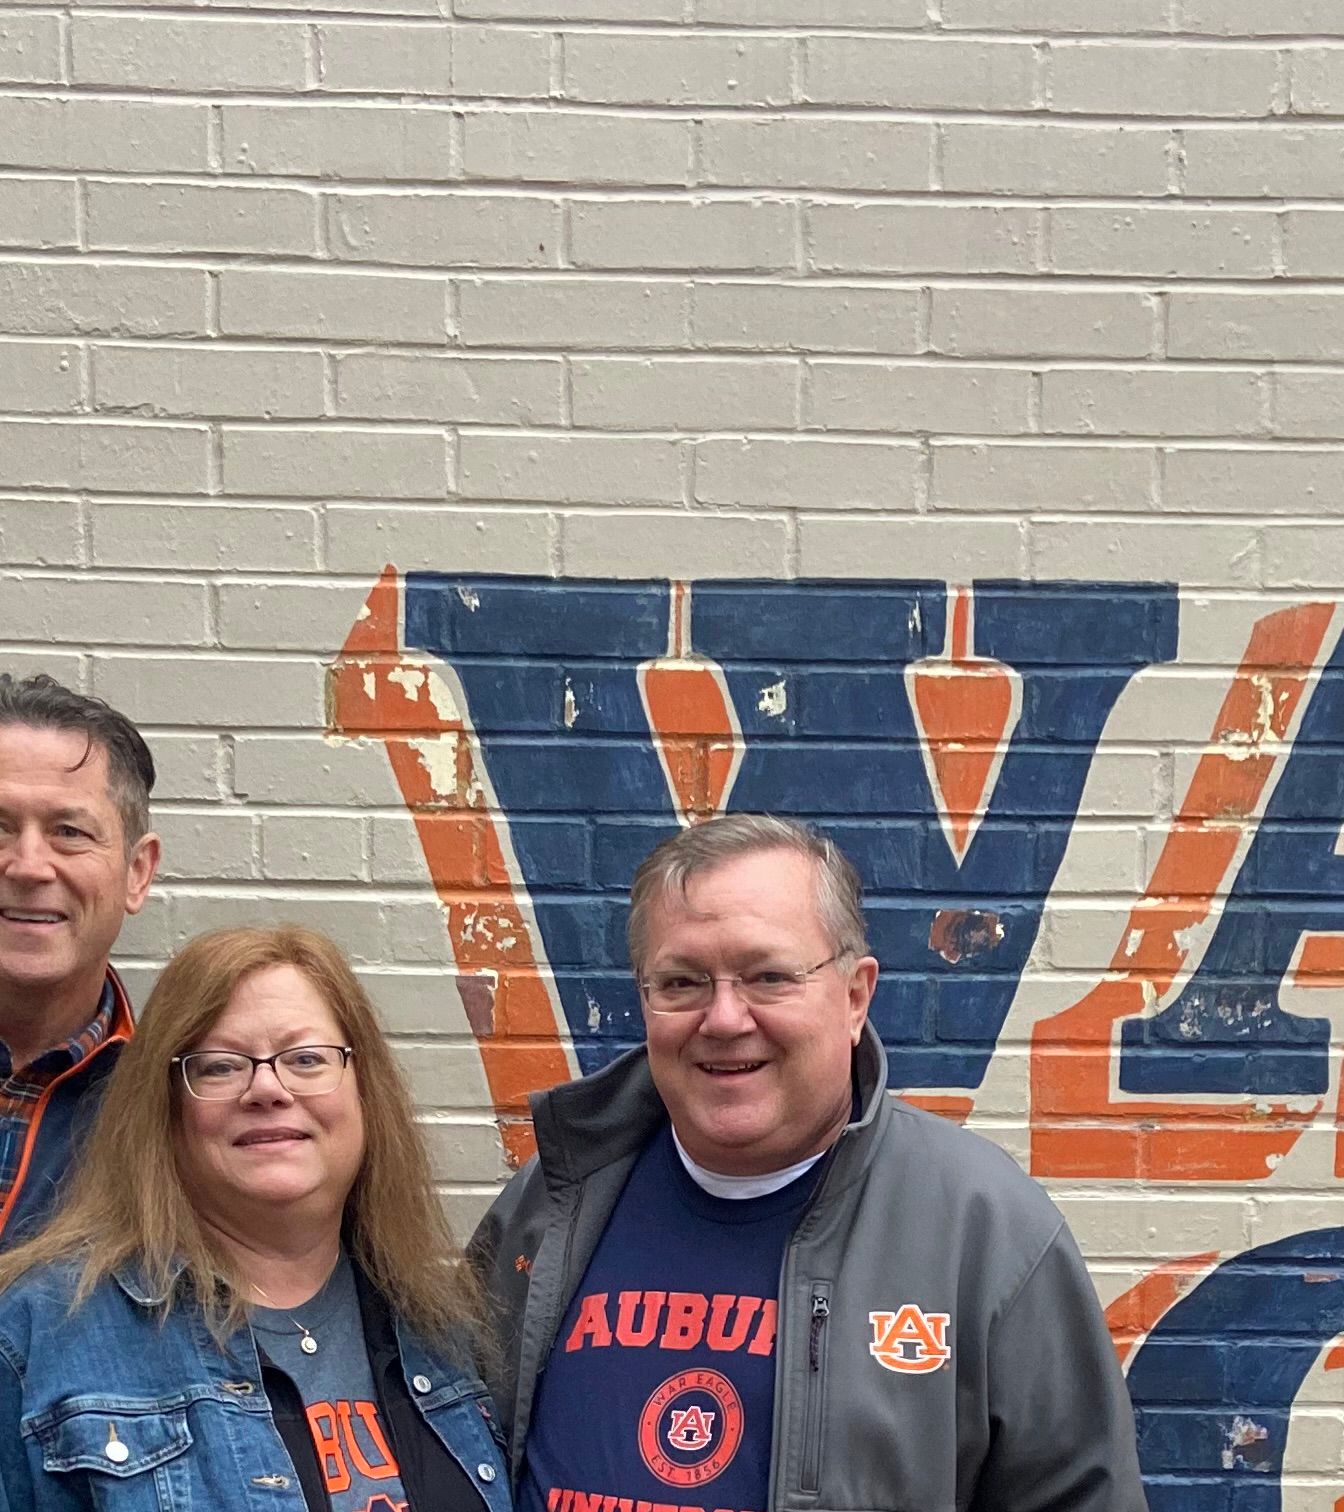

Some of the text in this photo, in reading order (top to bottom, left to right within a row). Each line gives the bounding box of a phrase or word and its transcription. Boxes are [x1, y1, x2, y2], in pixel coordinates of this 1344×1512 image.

[868, 1303, 951, 1374] AU
[653, 1374, 737, 1410] WAR EAGLE
[668, 1405, 716, 1450] AU
[686, 1459, 720, 1481] 1856
